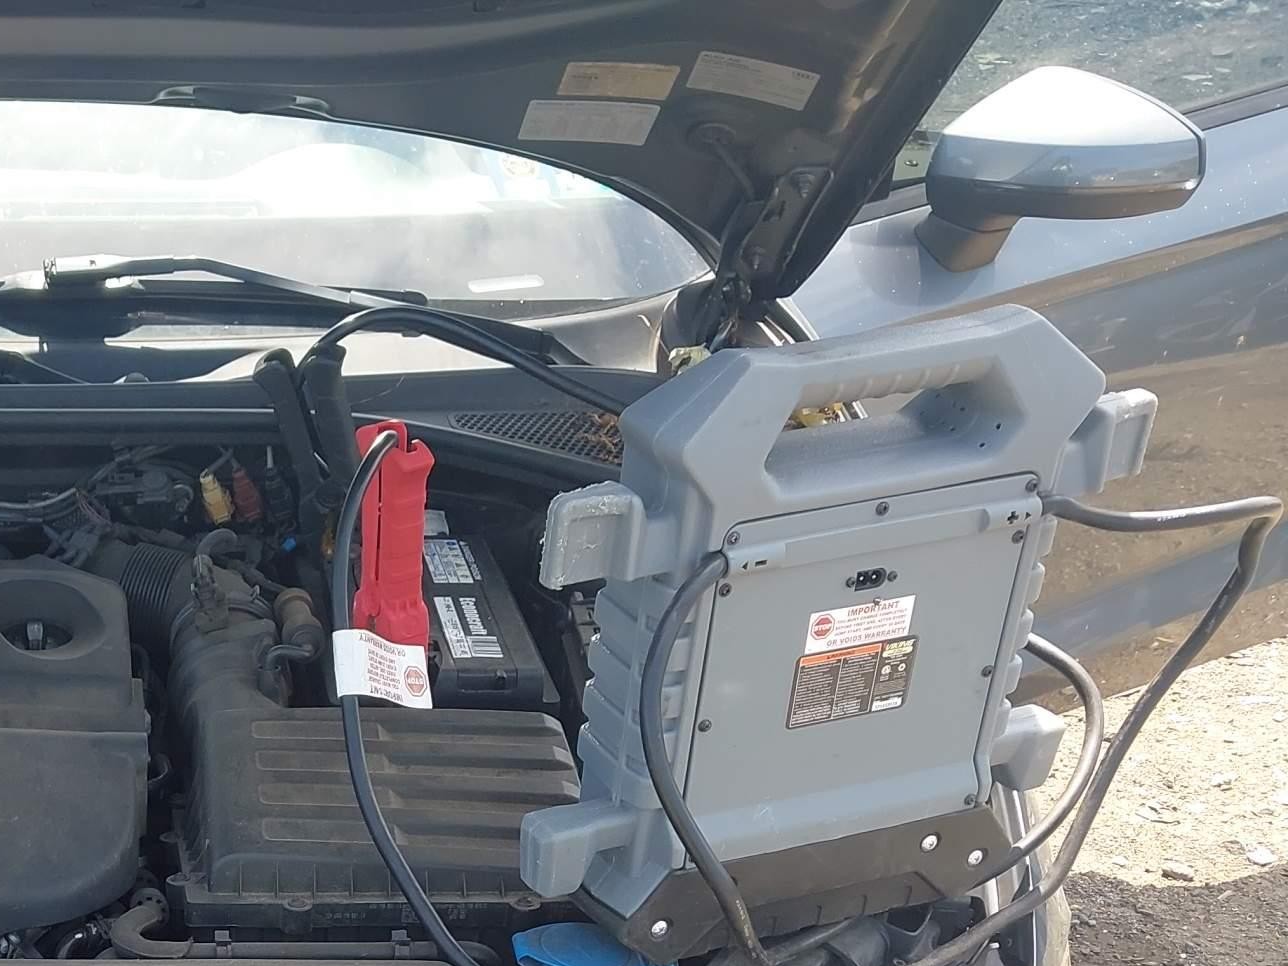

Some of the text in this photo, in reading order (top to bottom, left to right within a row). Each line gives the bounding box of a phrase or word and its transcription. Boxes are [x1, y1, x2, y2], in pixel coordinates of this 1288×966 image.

[459, 597, 488, 635] Econocraft
[847, 600, 900, 617] IMPORTANT
[826, 627, 906, 647] OR VOIDS WARRANTY
